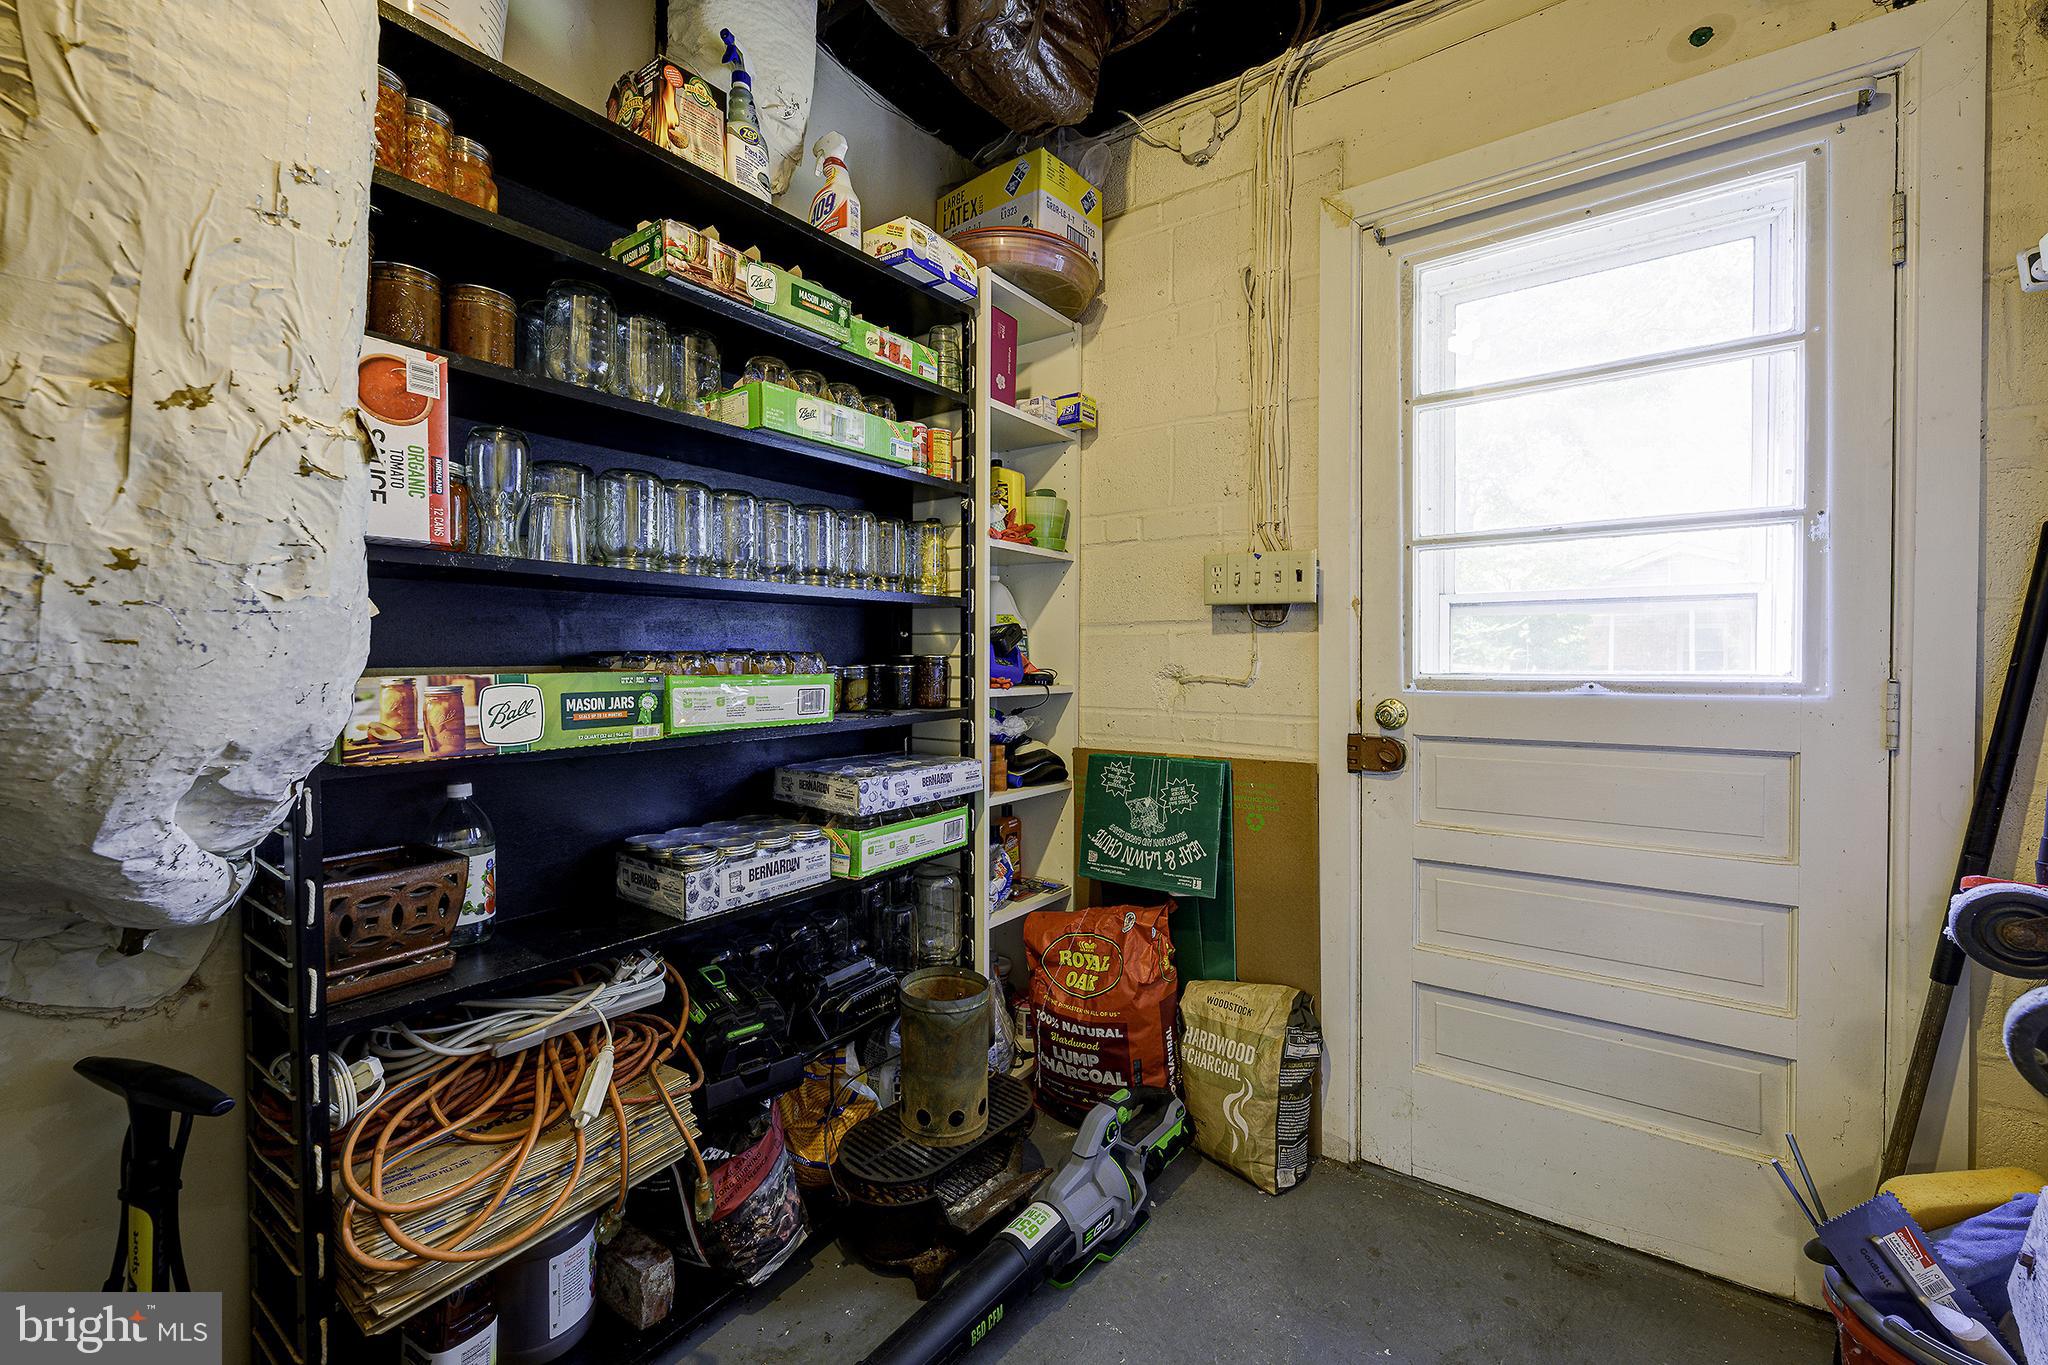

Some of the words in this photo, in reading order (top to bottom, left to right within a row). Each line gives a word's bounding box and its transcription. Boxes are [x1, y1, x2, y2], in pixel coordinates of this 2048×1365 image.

[811, 192, 836, 225] 409
[943, 190, 965, 212] LARGE
[943, 198, 979, 232] LATEX
[750, 275, 773, 290] Ball
[798, 289, 819, 306] MASON
[819, 296, 834, 312] JARS
[798, 407, 817, 421] Ball
[390, 449, 404, 489] TOMATO
[407, 445, 425, 499] ORGANIC
[435, 458, 443, 494] KIRKLAND
[434, 507, 444, 519] 12
[434, 519, 444, 537] CANS
[488, 698, 537, 730] Ball
[566, 697, 605, 712] MASON
[608, 696, 635, 710] JARS
[798, 778, 830, 794] BERNARDIN
[922, 772, 953, 788] BERNARDIN
[1093, 829, 1122, 859] CHUTE
[1178, 839, 1208, 866] LEAF
[748, 857, 800, 883] BERNARDIN
[1120, 847, 1162, 871] LAWN
[1164, 849, 1177, 870] &
[1058, 949, 1110, 972] ROYAL
[1065, 971, 1099, 992] OAK
[1206, 995, 1253, 1017] WOODSTOCK
[1036, 1009, 1060, 1029] 100%
[1061, 1020, 1124, 1039] NATURAL
[1050, 1031, 1100, 1051] Hardwood
[1183, 1026, 1256, 1065] HARDWOOD
[1052, 1045, 1100, 1067] LUMP
[1187, 1049, 1241, 1082] CHARCOAL
[1039, 1051, 1128, 1087] CHARCOAL
[714, 1180, 735, 1199] LONG
[735, 1152, 763, 1181] BURNING
[1024, 1209, 1048, 1225] CFM
[1008, 1218, 1040, 1240] 650
[1085, 1213, 1111, 1245] EGO
[132, 1230, 140, 1274] Sport
[1896, 1231, 1920, 1259] Goldblatt
[1859, 1247, 1893, 1288] Goldblatt
[971, 1320, 988, 1347] 650
[987, 1304, 1004, 1329] CFM
